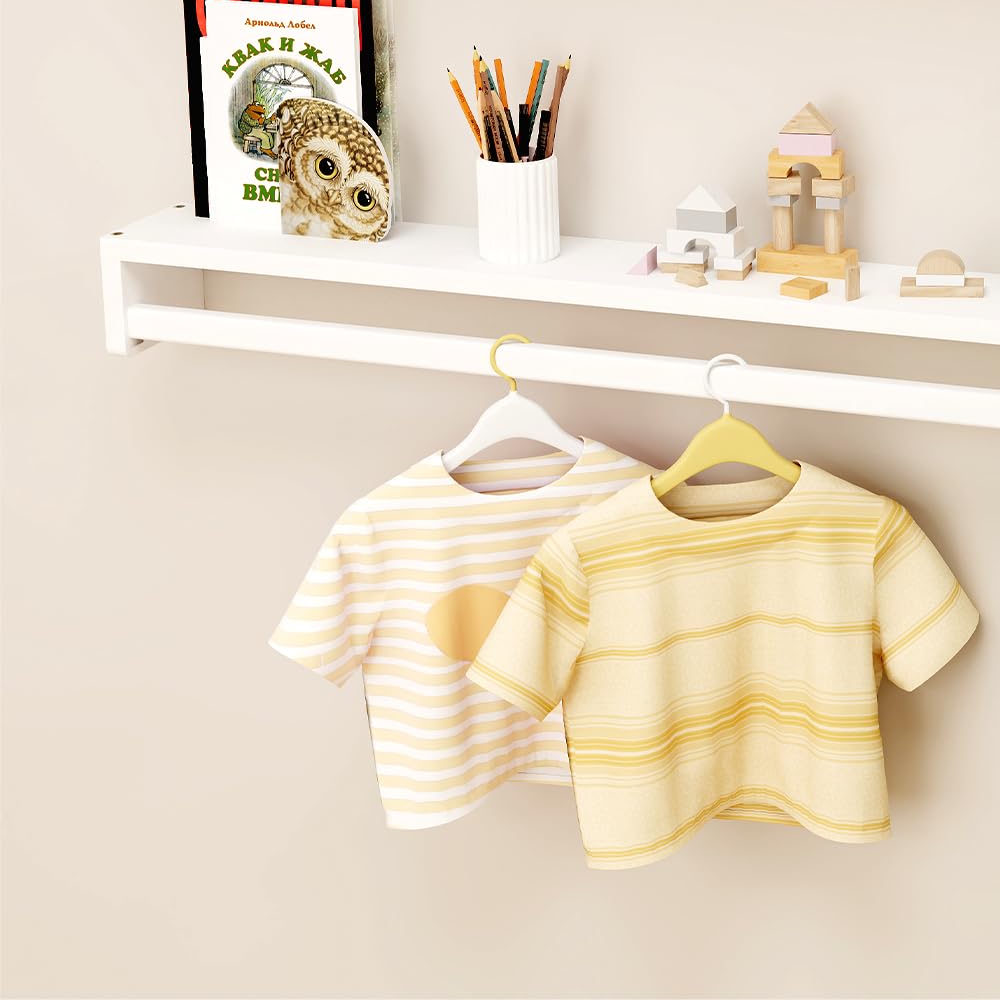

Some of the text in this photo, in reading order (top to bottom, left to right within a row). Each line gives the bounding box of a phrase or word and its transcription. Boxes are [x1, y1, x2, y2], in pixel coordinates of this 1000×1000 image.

[244, 18, 316, 30] Арнольд Лобел
[222, 37, 347, 85] КВАК И ЖАБ
